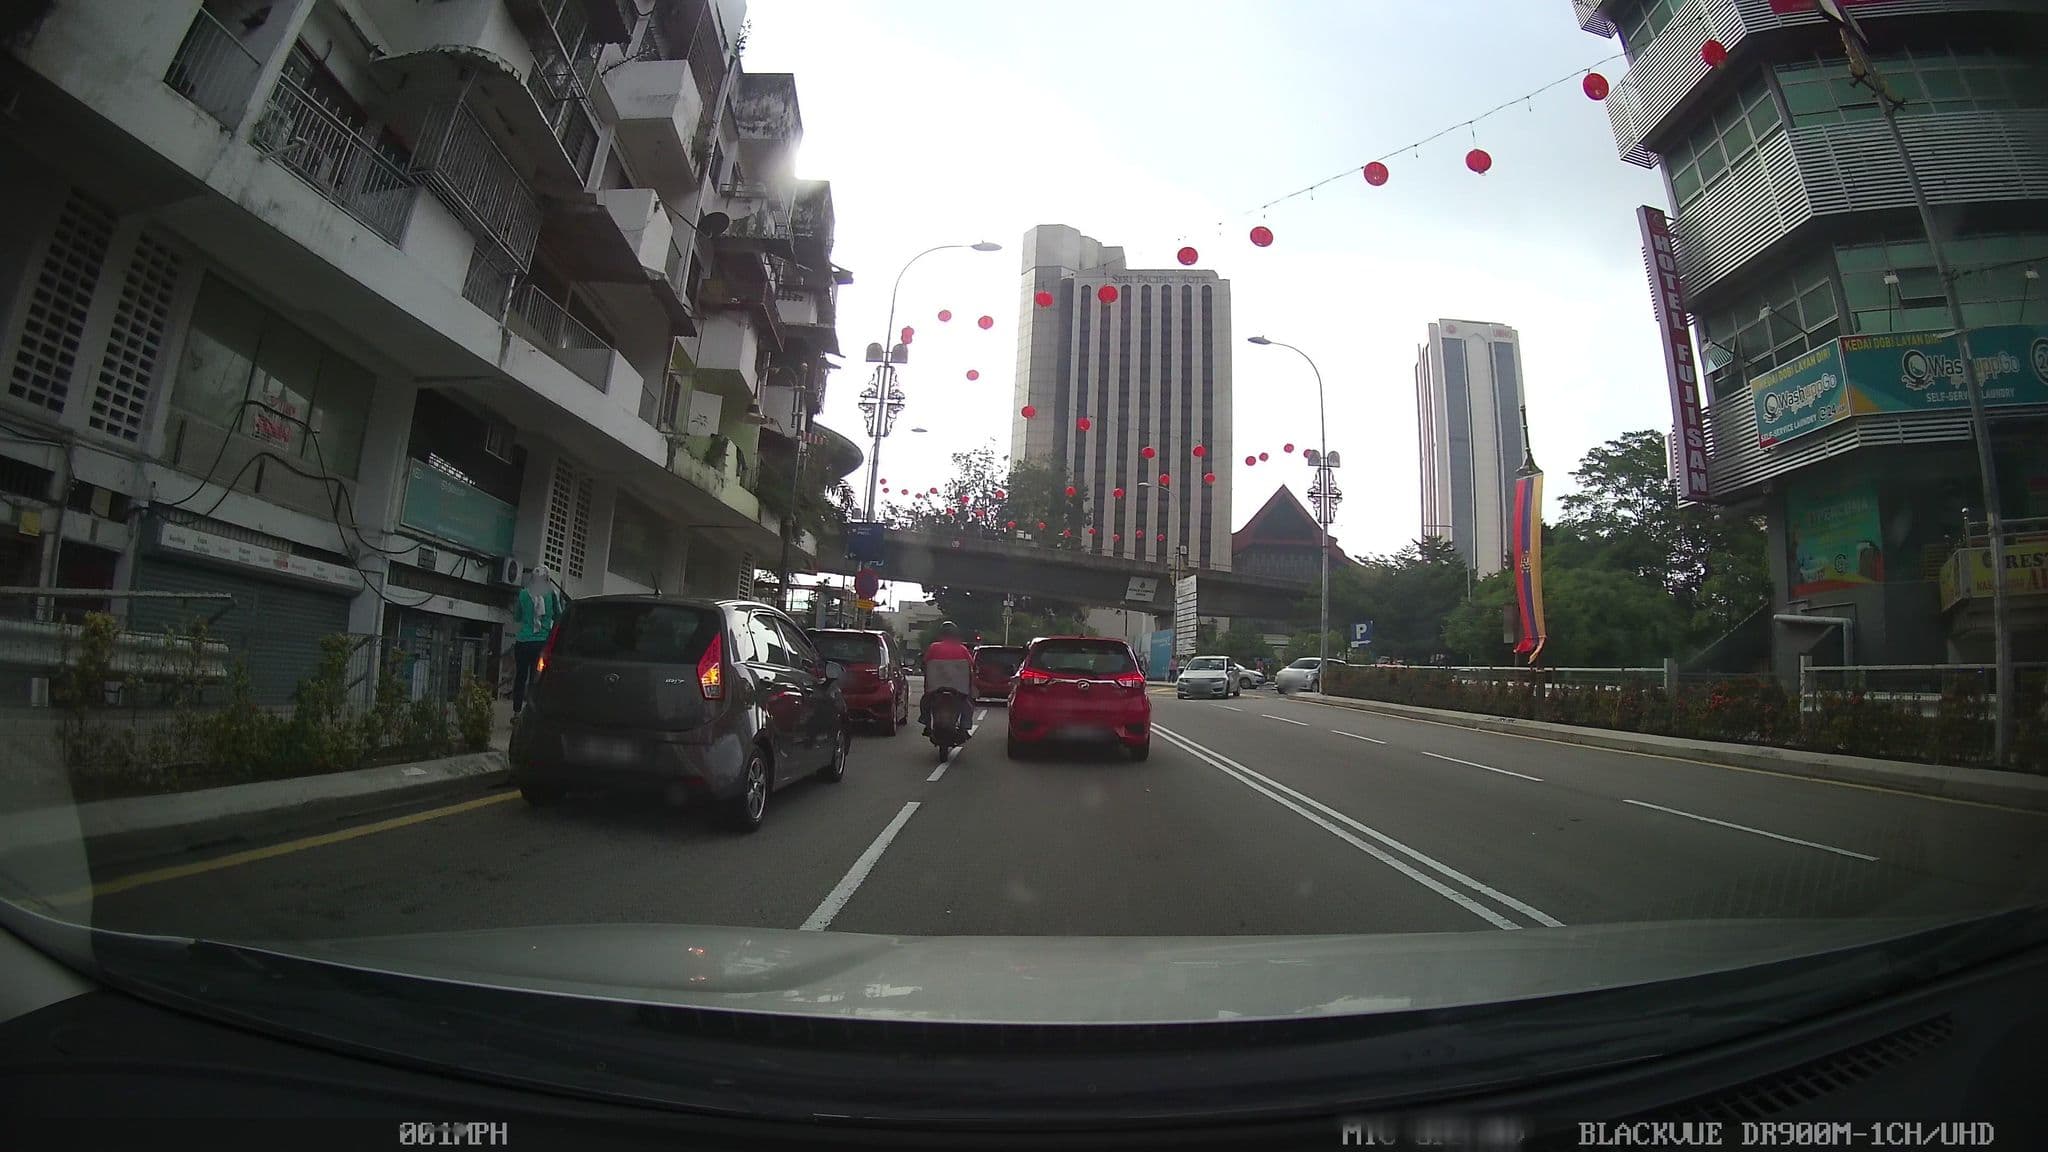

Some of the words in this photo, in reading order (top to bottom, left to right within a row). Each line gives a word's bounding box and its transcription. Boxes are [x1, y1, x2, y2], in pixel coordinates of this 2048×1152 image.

[1845, 339, 1872, 351] KEDAI
[1873, 337, 1895, 349] DOBI
[1896, 335, 1925, 347] LAYAN
[1653, 234, 1685, 331] HOTEL
[1676, 343, 1707, 493] FUJISAN
[1926, 351, 2020, 379] WasuppGo
[1760, 423, 1794, 443] SELF-SERVICE
[1355, 623, 1368, 640] P
